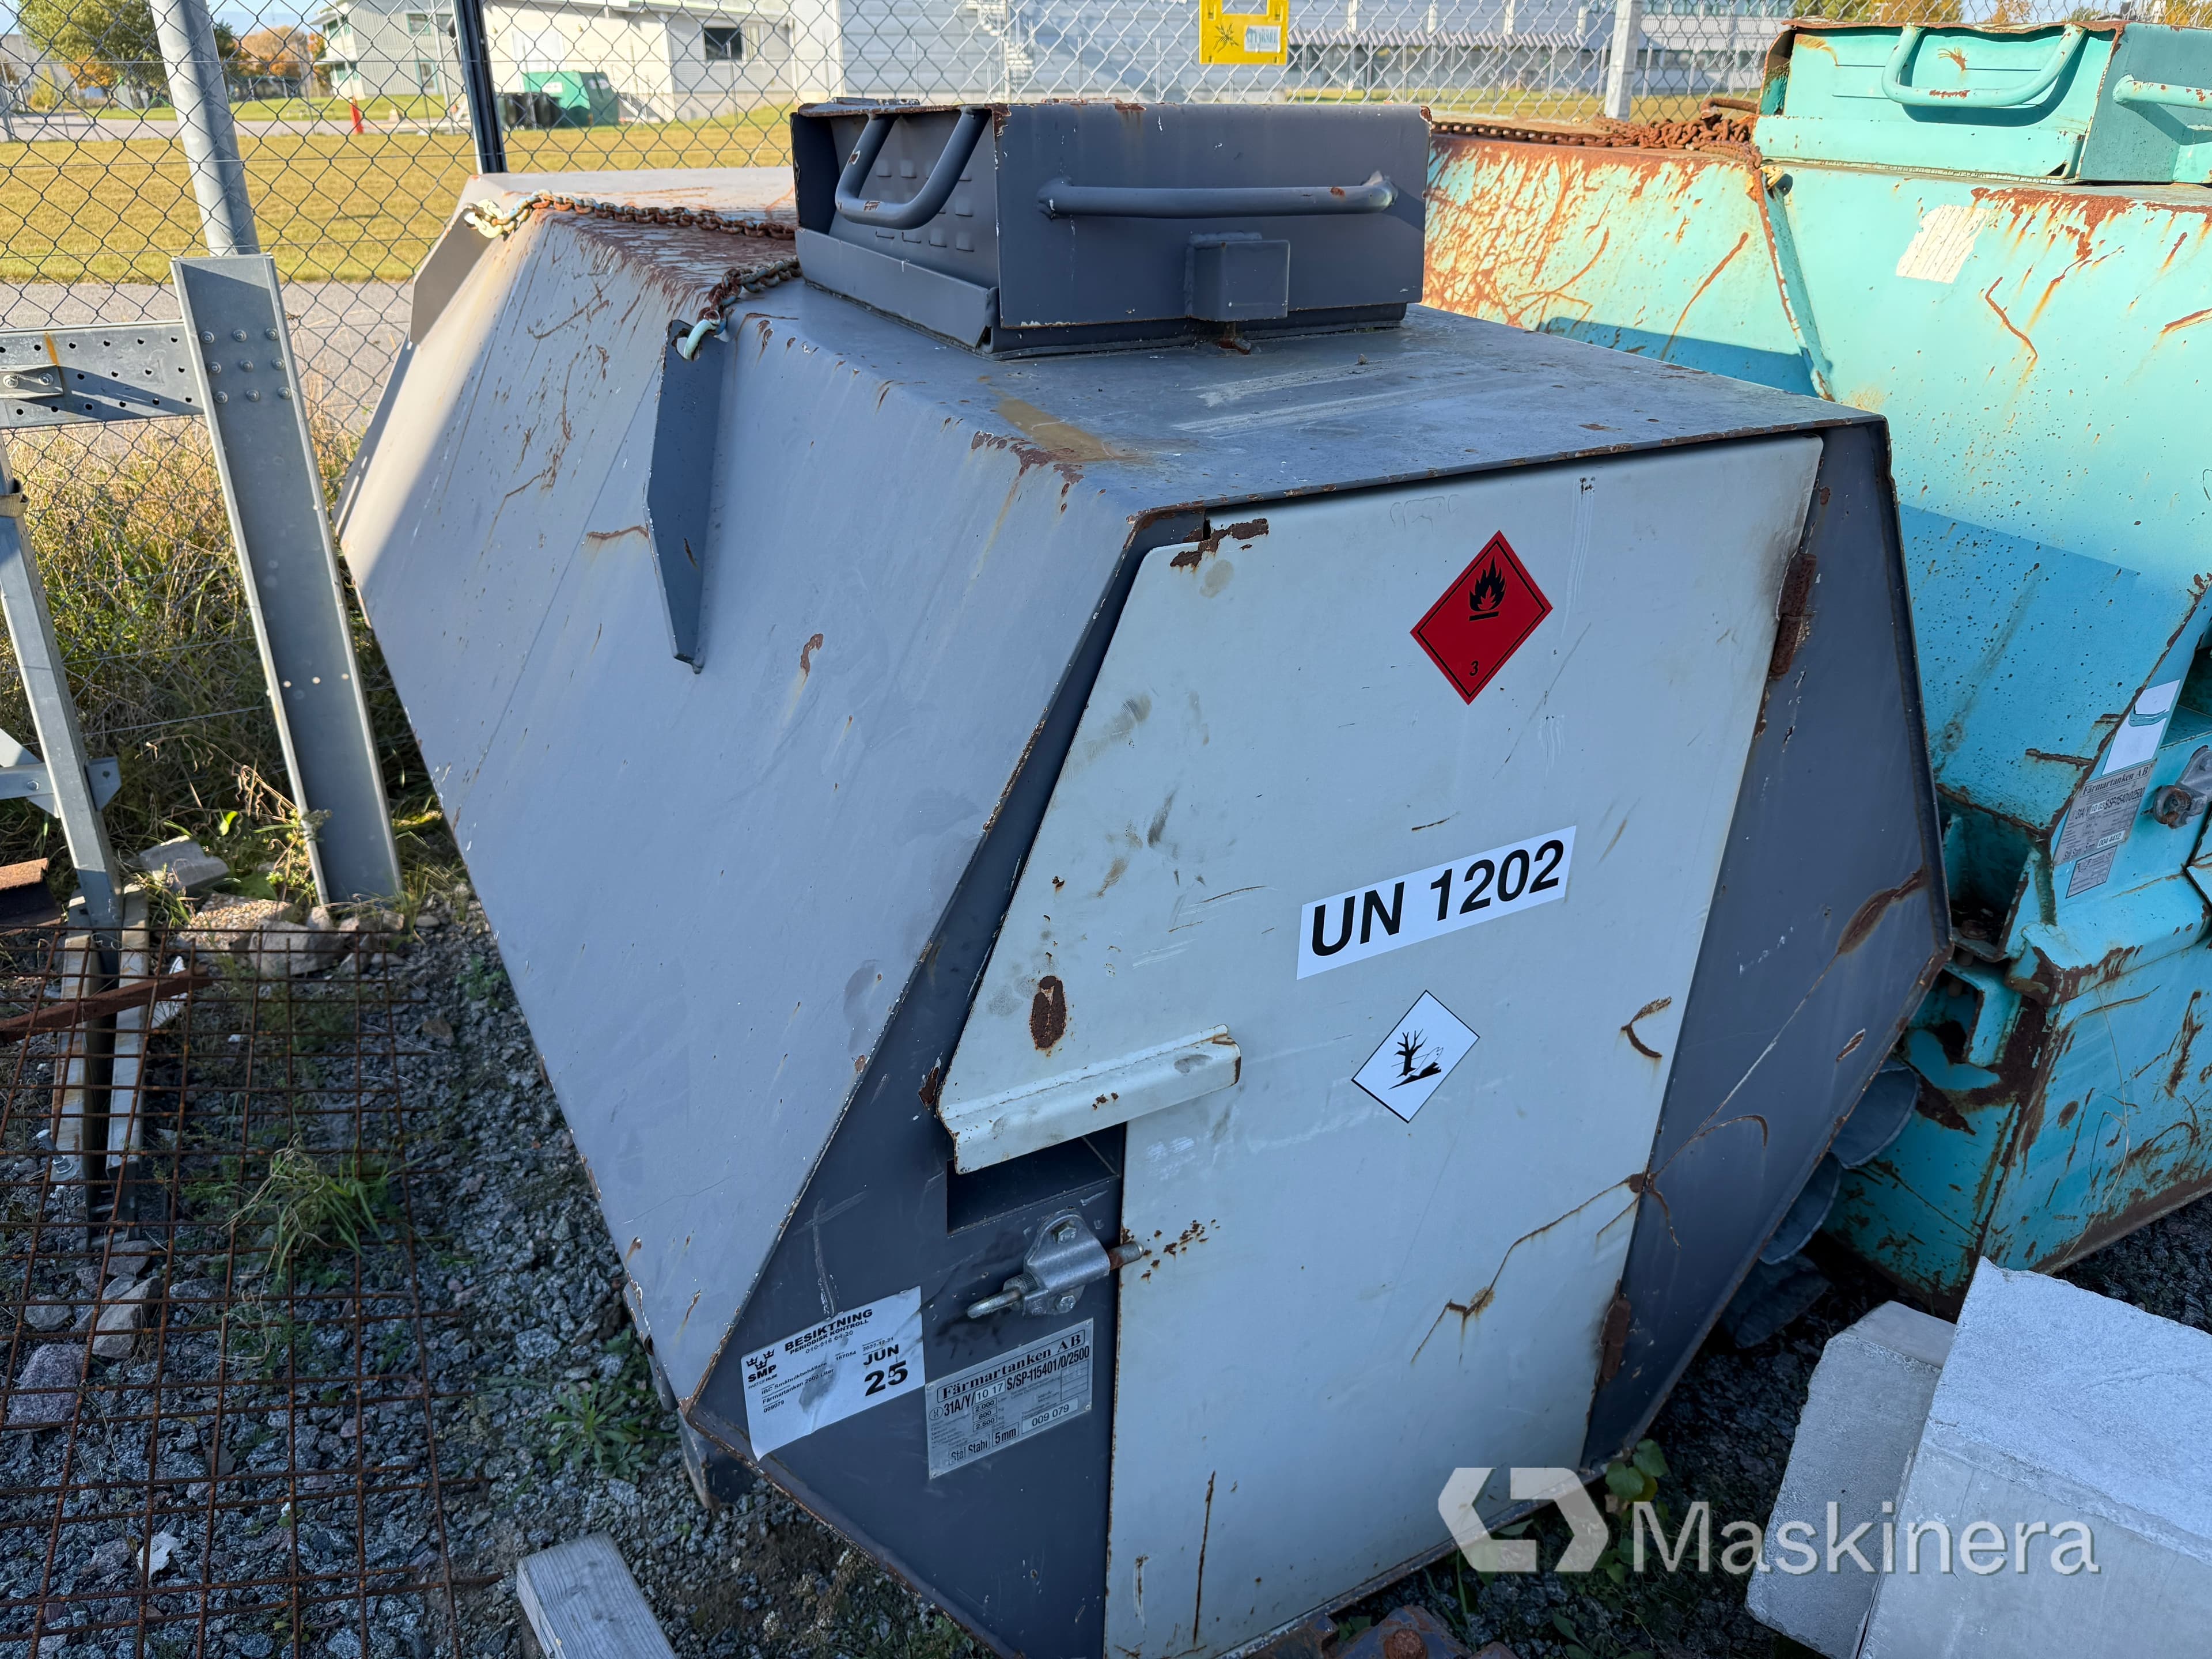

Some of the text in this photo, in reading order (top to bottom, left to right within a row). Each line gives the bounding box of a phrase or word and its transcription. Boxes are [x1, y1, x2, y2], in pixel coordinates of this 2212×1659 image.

[1469, 660, 1479, 676] 3
[2137, 766, 2149, 777] AB
[1312, 839, 1564, 956] UN 1202
[785, 1309, 873, 1351] BESIKTNING
[790, 1319, 869, 1355] PERIODISK KONTROLL
[863, 1344, 899, 1365] JUN
[942, 1349, 1051, 1399] Färmartanken
[1057, 1334, 1081, 1353] AB
[748, 1364, 777, 1382] SMP
[864, 1360, 908, 1397] 25
[762, 1381, 804, 1404] Färmartanken
[805, 1374, 819, 1384] 2000
[976, 1389, 988, 1400] 10
[992, 1382, 1003, 1394] 17
[1032, 1412, 1050, 1427] 009
[1052, 1404, 1069, 1417] 079
